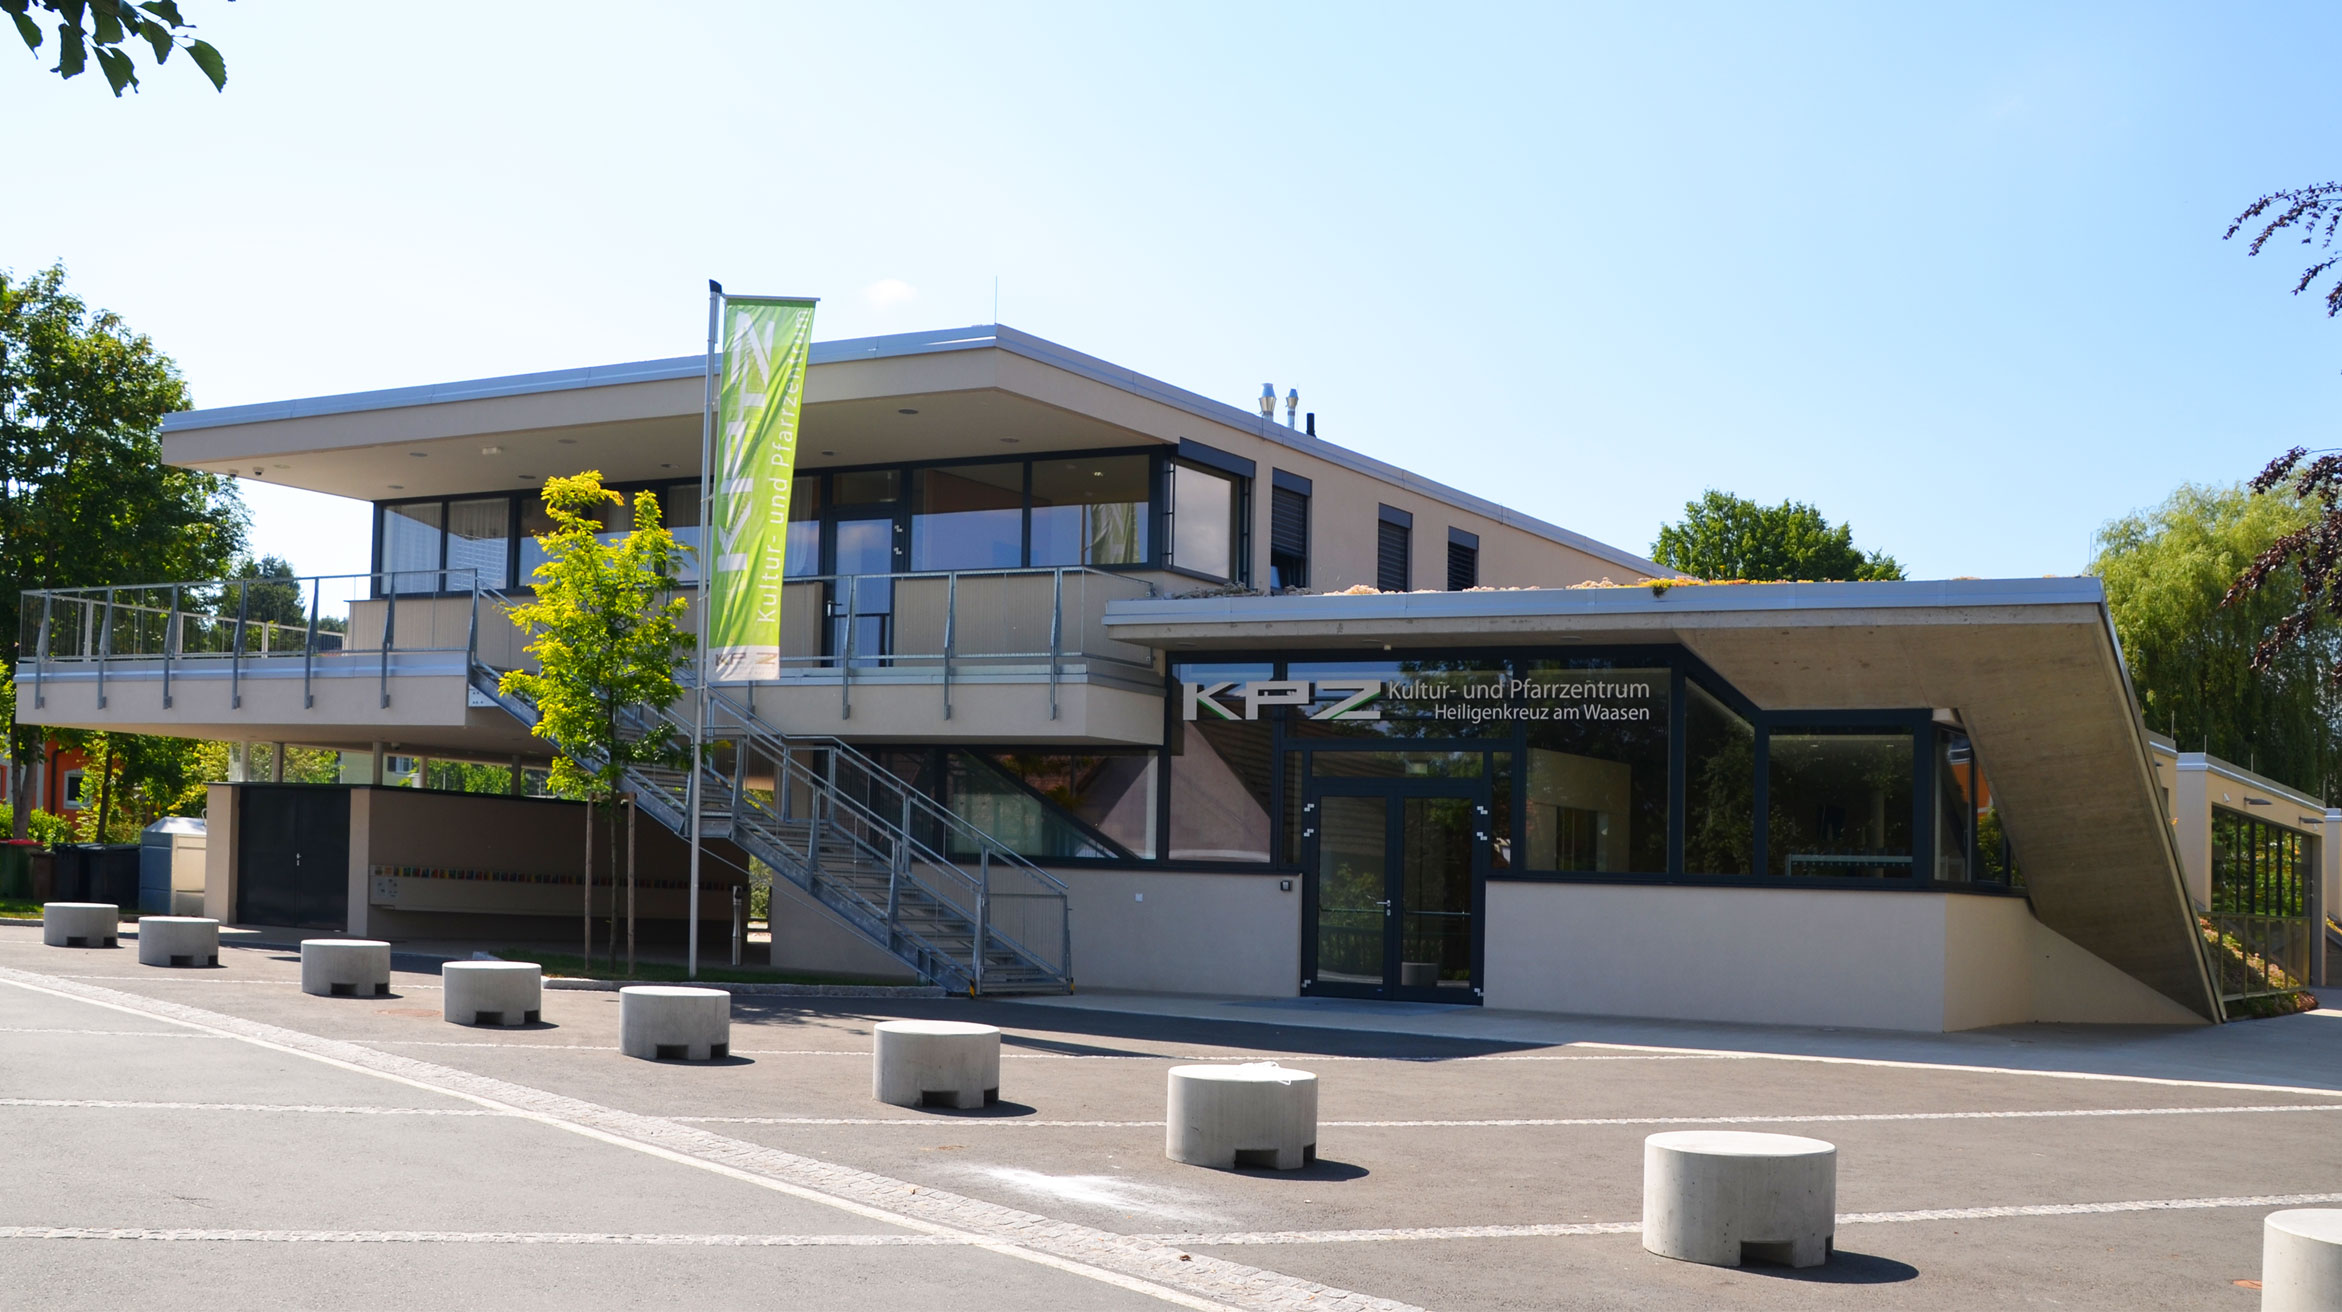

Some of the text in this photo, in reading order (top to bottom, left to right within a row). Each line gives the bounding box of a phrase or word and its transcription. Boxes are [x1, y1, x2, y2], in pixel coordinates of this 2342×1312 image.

[717, 311, 775, 572] KPZ
[757, 309, 809, 622] Kultur- und Pfarrzentrum
[1183, 680, 1381, 720] KPZ
[1389, 678, 1650, 699] Kultur- und Pfarrzentrum
[1435, 703, 1650, 724] Heiligenkreuz am Waasen
